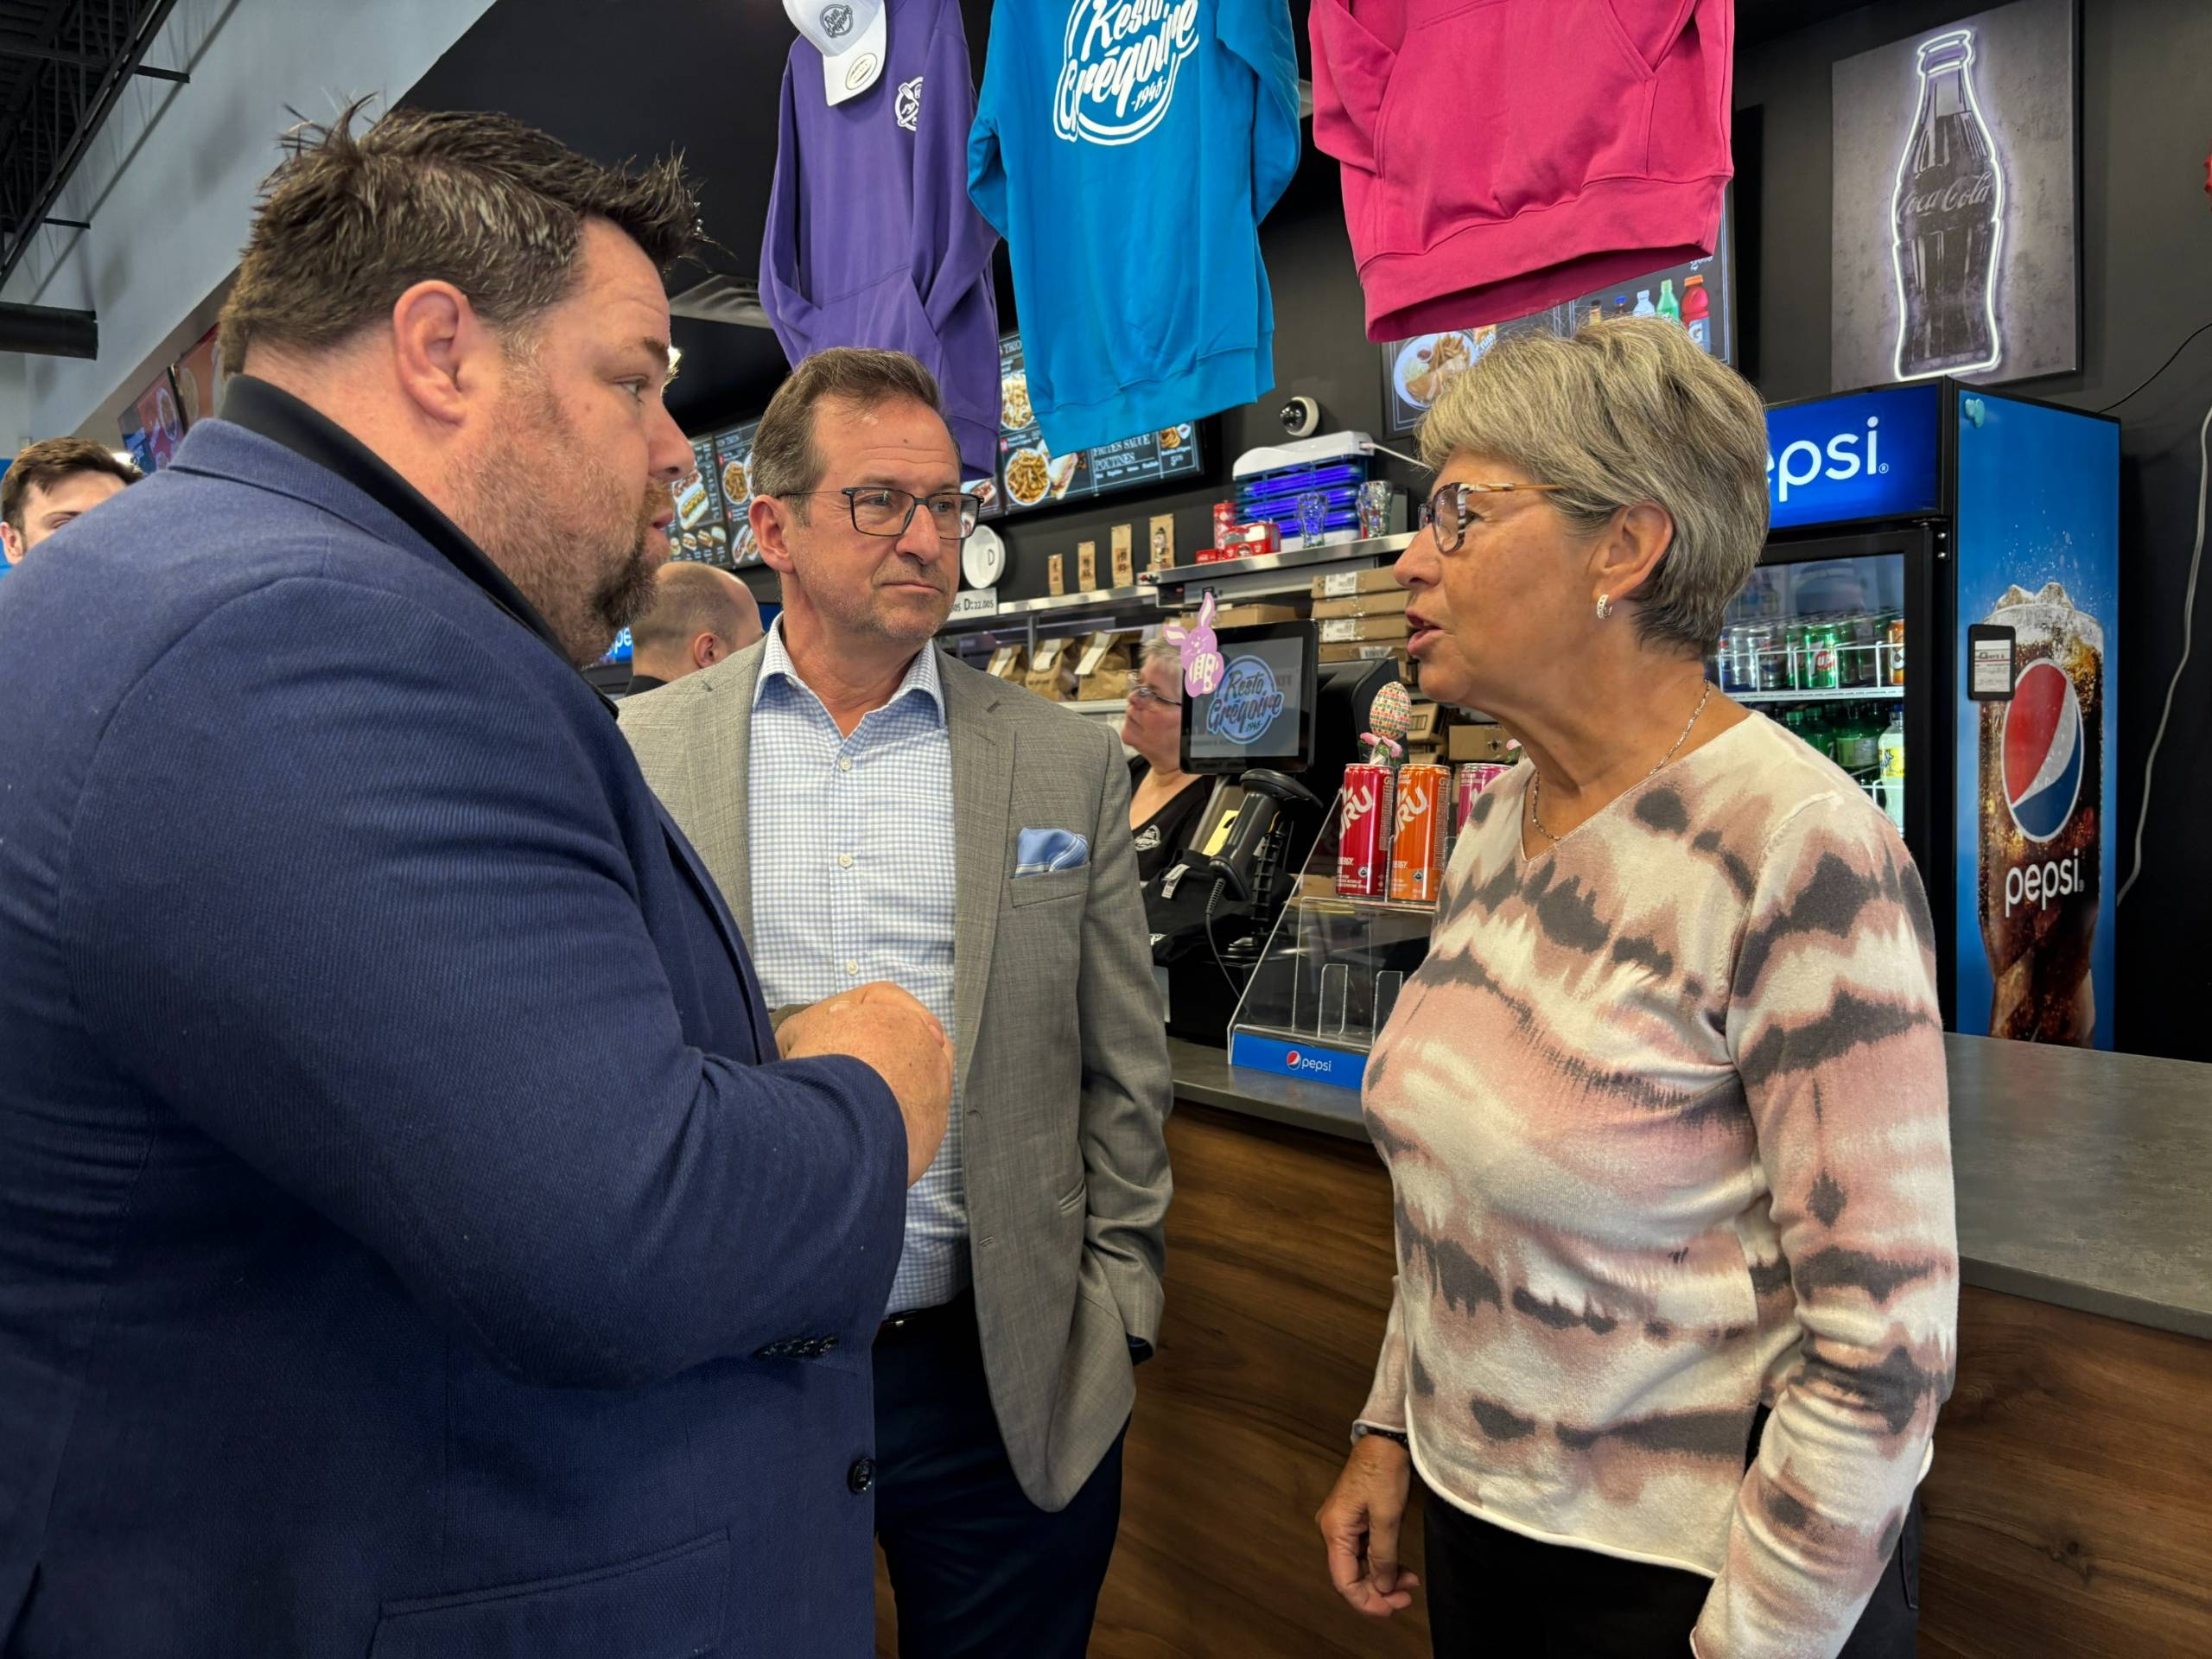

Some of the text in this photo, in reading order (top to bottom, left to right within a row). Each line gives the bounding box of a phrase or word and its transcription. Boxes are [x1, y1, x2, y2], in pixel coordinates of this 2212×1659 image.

[1060, 0, 1199, 132] Grégoire
[988, 548, 995, 567] D
[1224, 671, 1264, 702] Resto
[1209, 692, 1282, 733] Grégoire
[2005, 848, 2080, 918] pepsi
[1301, 1058, 1332, 1072] pepsi
